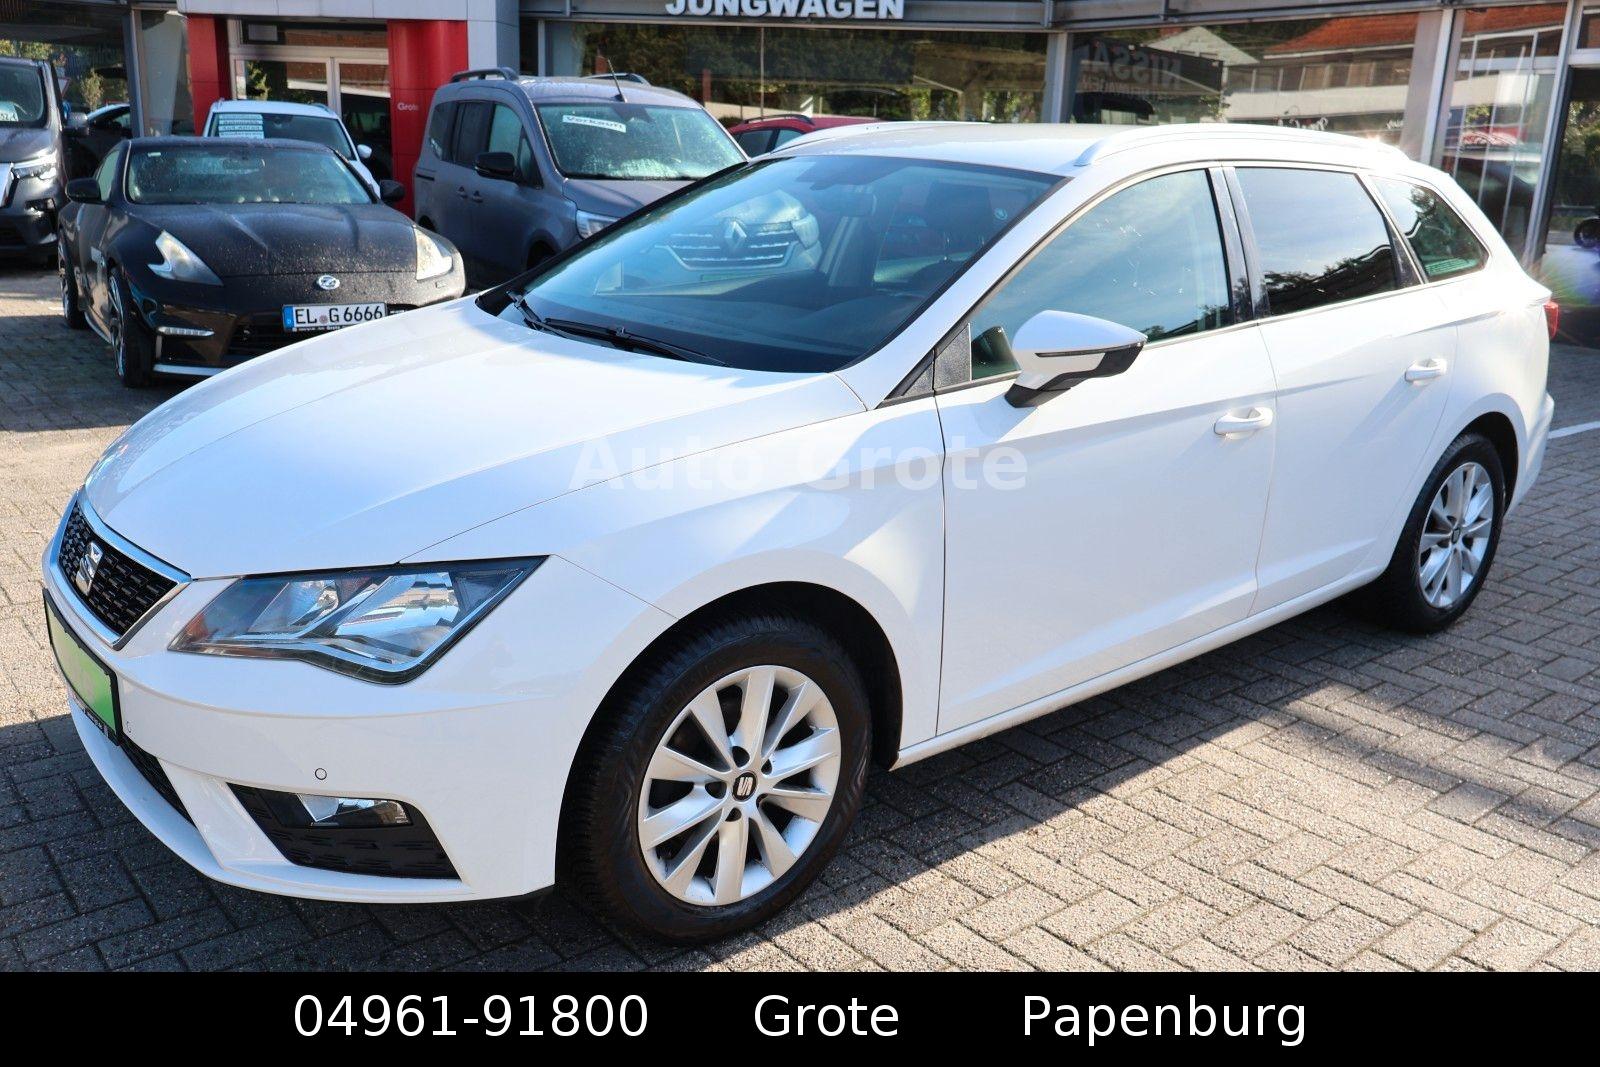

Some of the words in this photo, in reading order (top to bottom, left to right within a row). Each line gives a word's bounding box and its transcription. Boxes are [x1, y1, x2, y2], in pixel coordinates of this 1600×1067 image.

[665, 0, 904, 19] JUNGWAGEN
[295, 308, 317, 324] EL
[328, 307, 340, 322] G
[343, 305, 383, 322] 6666
